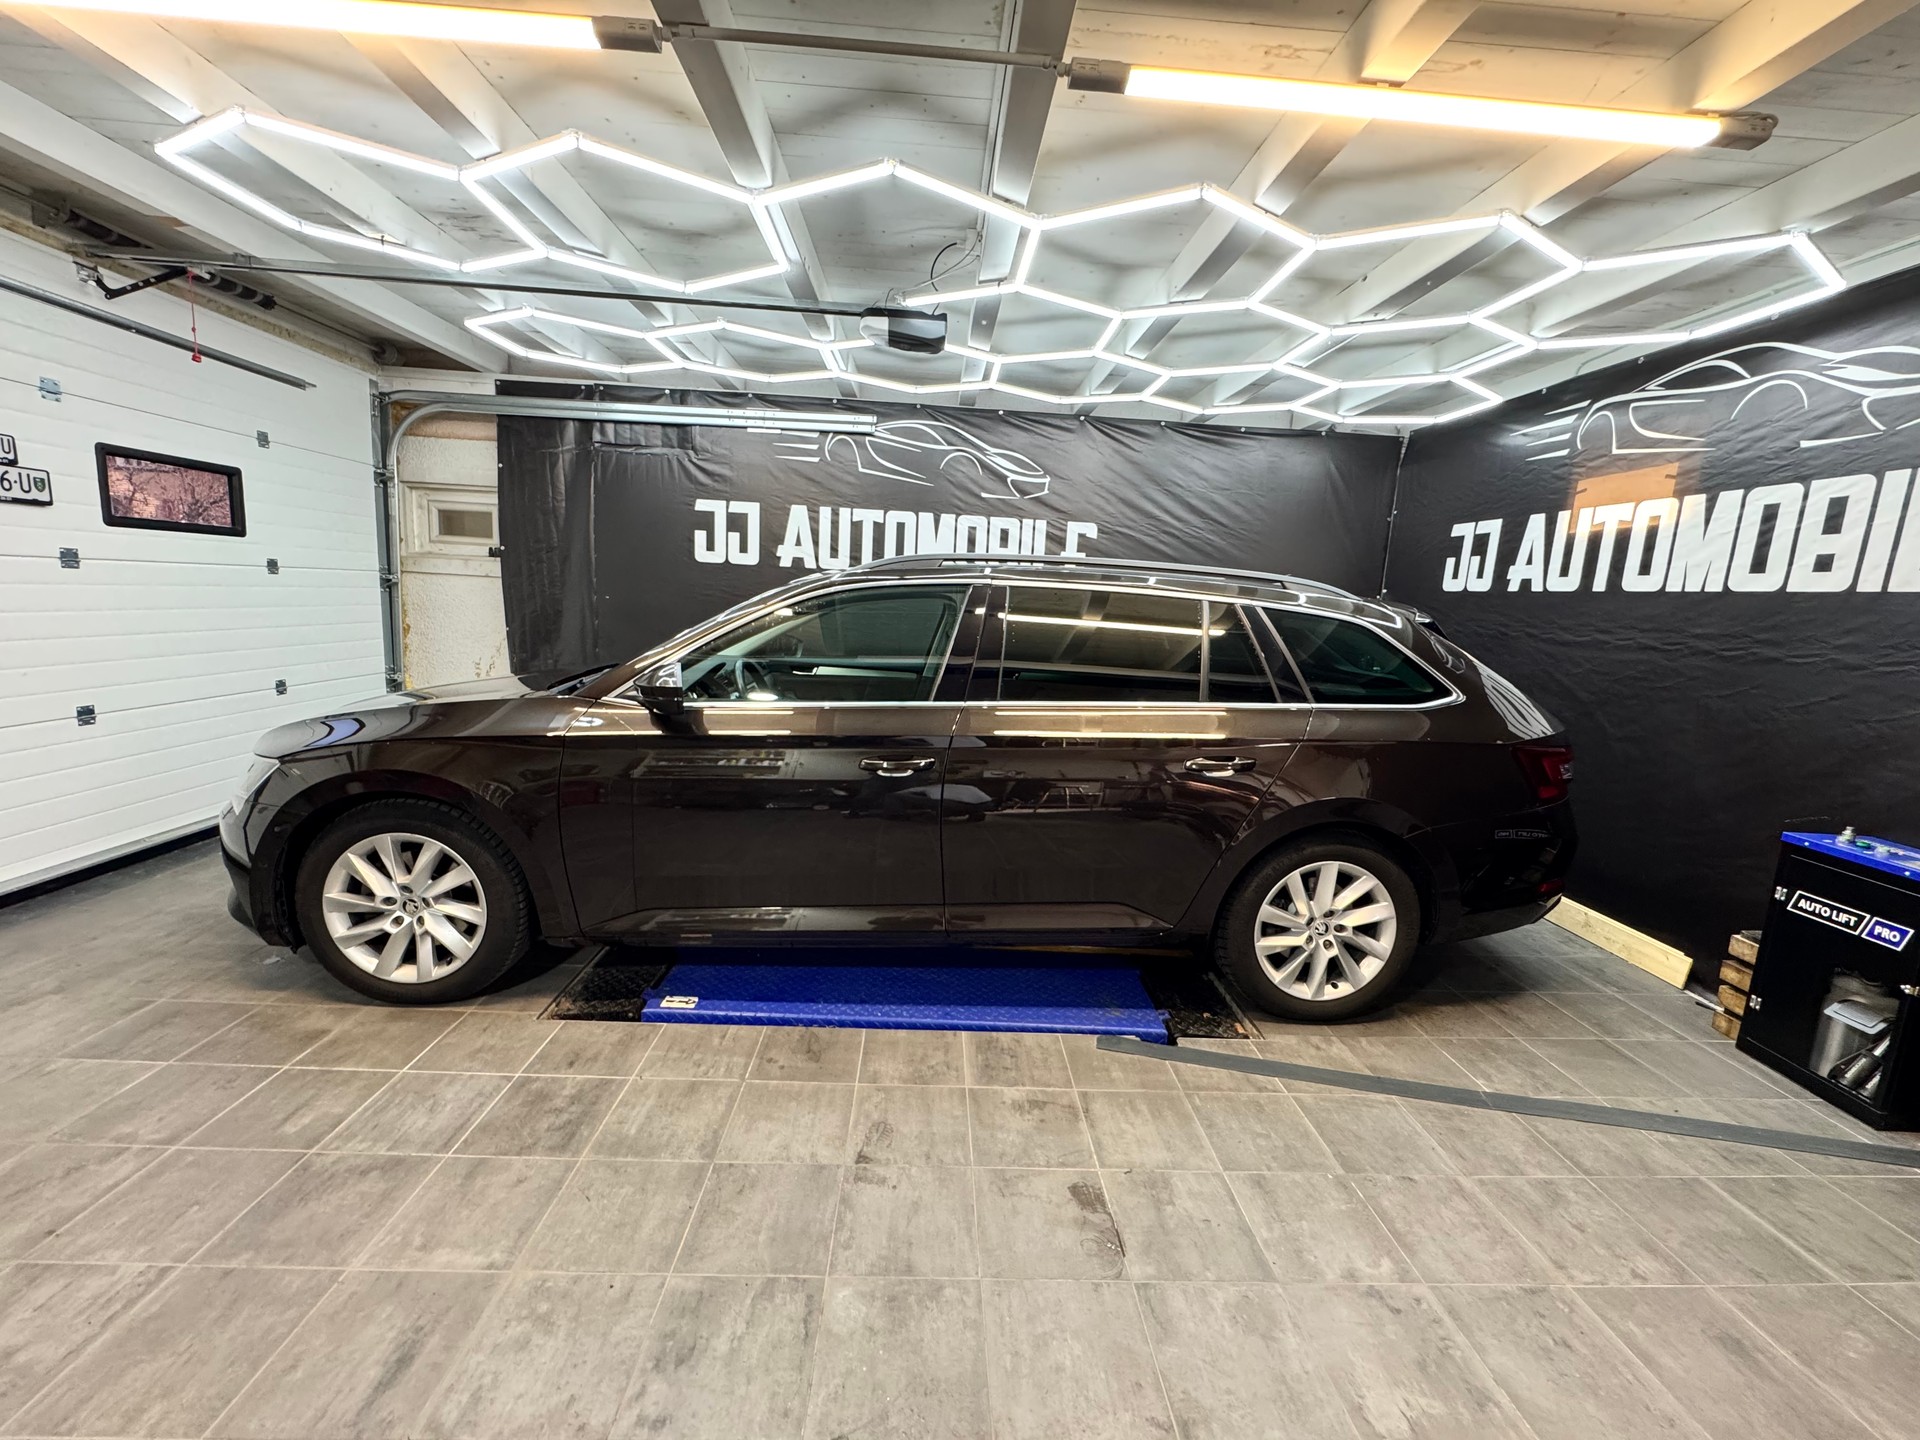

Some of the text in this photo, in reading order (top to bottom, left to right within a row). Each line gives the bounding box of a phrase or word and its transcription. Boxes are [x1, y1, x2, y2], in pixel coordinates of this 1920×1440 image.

[694, 499, 760, 566] JJ
[1442, 518, 1503, 592] JJ
[1797, 898, 1901, 943] AUTO LIFT PRO
